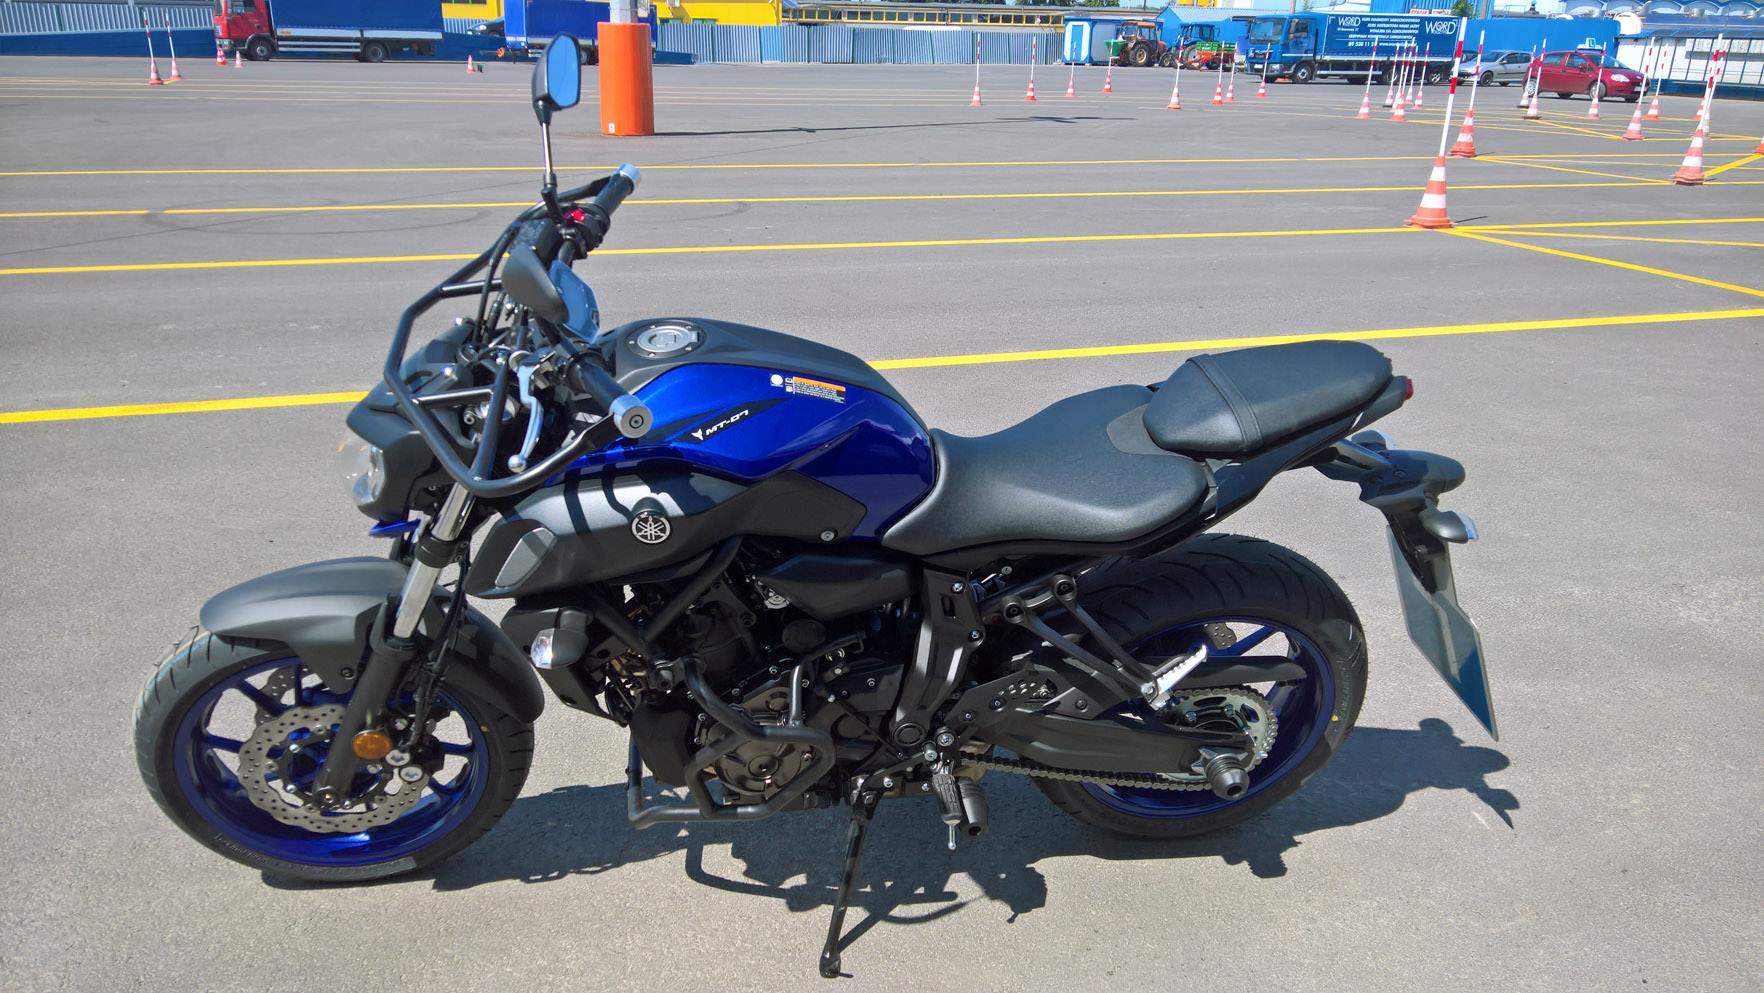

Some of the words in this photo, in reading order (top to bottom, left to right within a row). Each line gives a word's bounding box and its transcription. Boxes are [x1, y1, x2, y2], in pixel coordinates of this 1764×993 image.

[1338, 16, 1361, 26] WORD
[1425, 20, 1456, 34] WORD
[706, 410, 748, 436] MT-07
